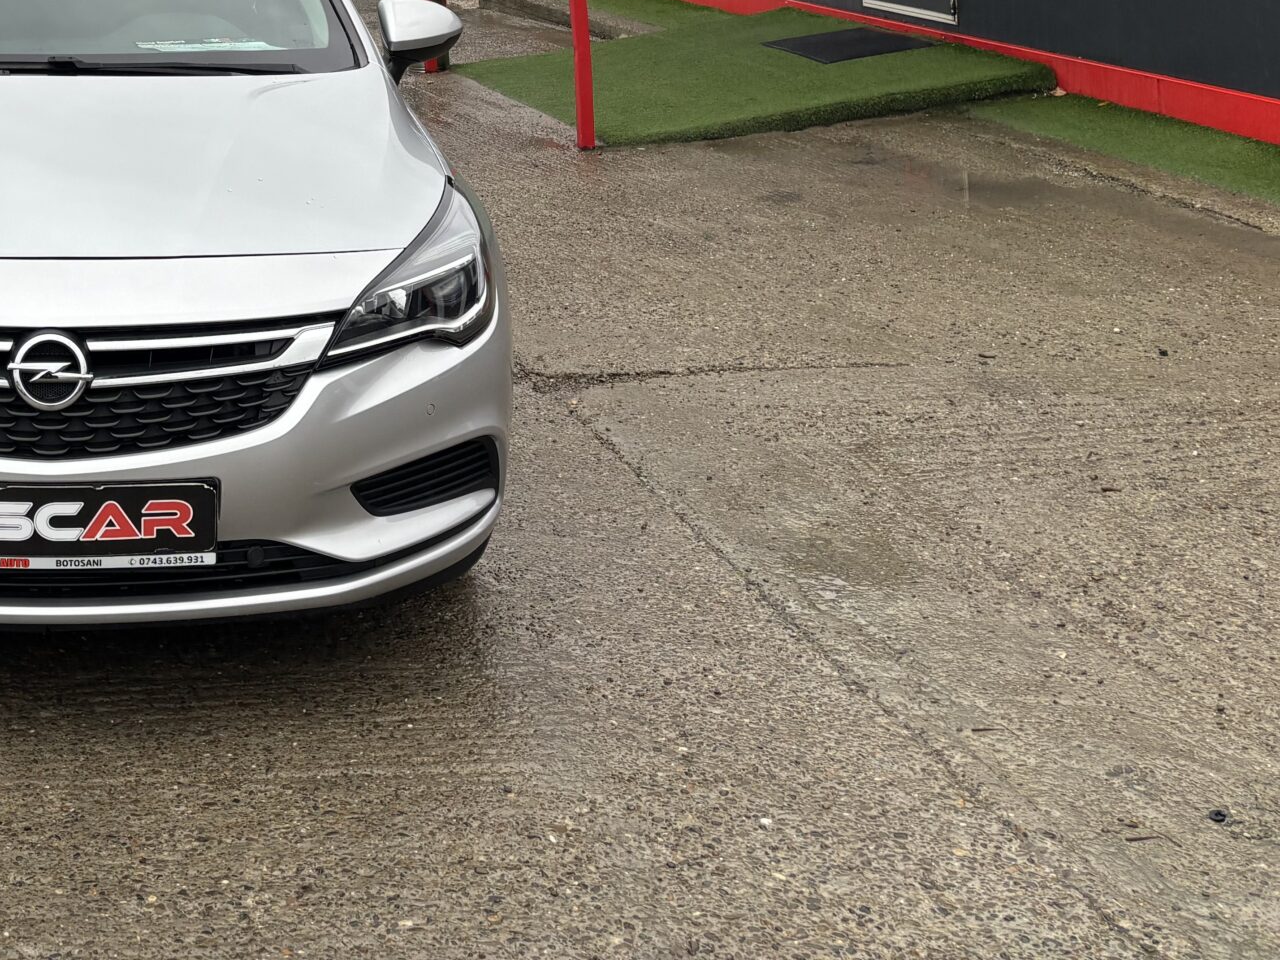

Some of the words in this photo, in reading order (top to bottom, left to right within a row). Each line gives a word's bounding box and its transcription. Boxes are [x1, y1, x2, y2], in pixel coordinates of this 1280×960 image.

[0, 558, 30, 568] AUTO
[55, 559, 102, 567] BOTOSANI
[139, 555, 205, 566] 0743.639.931
